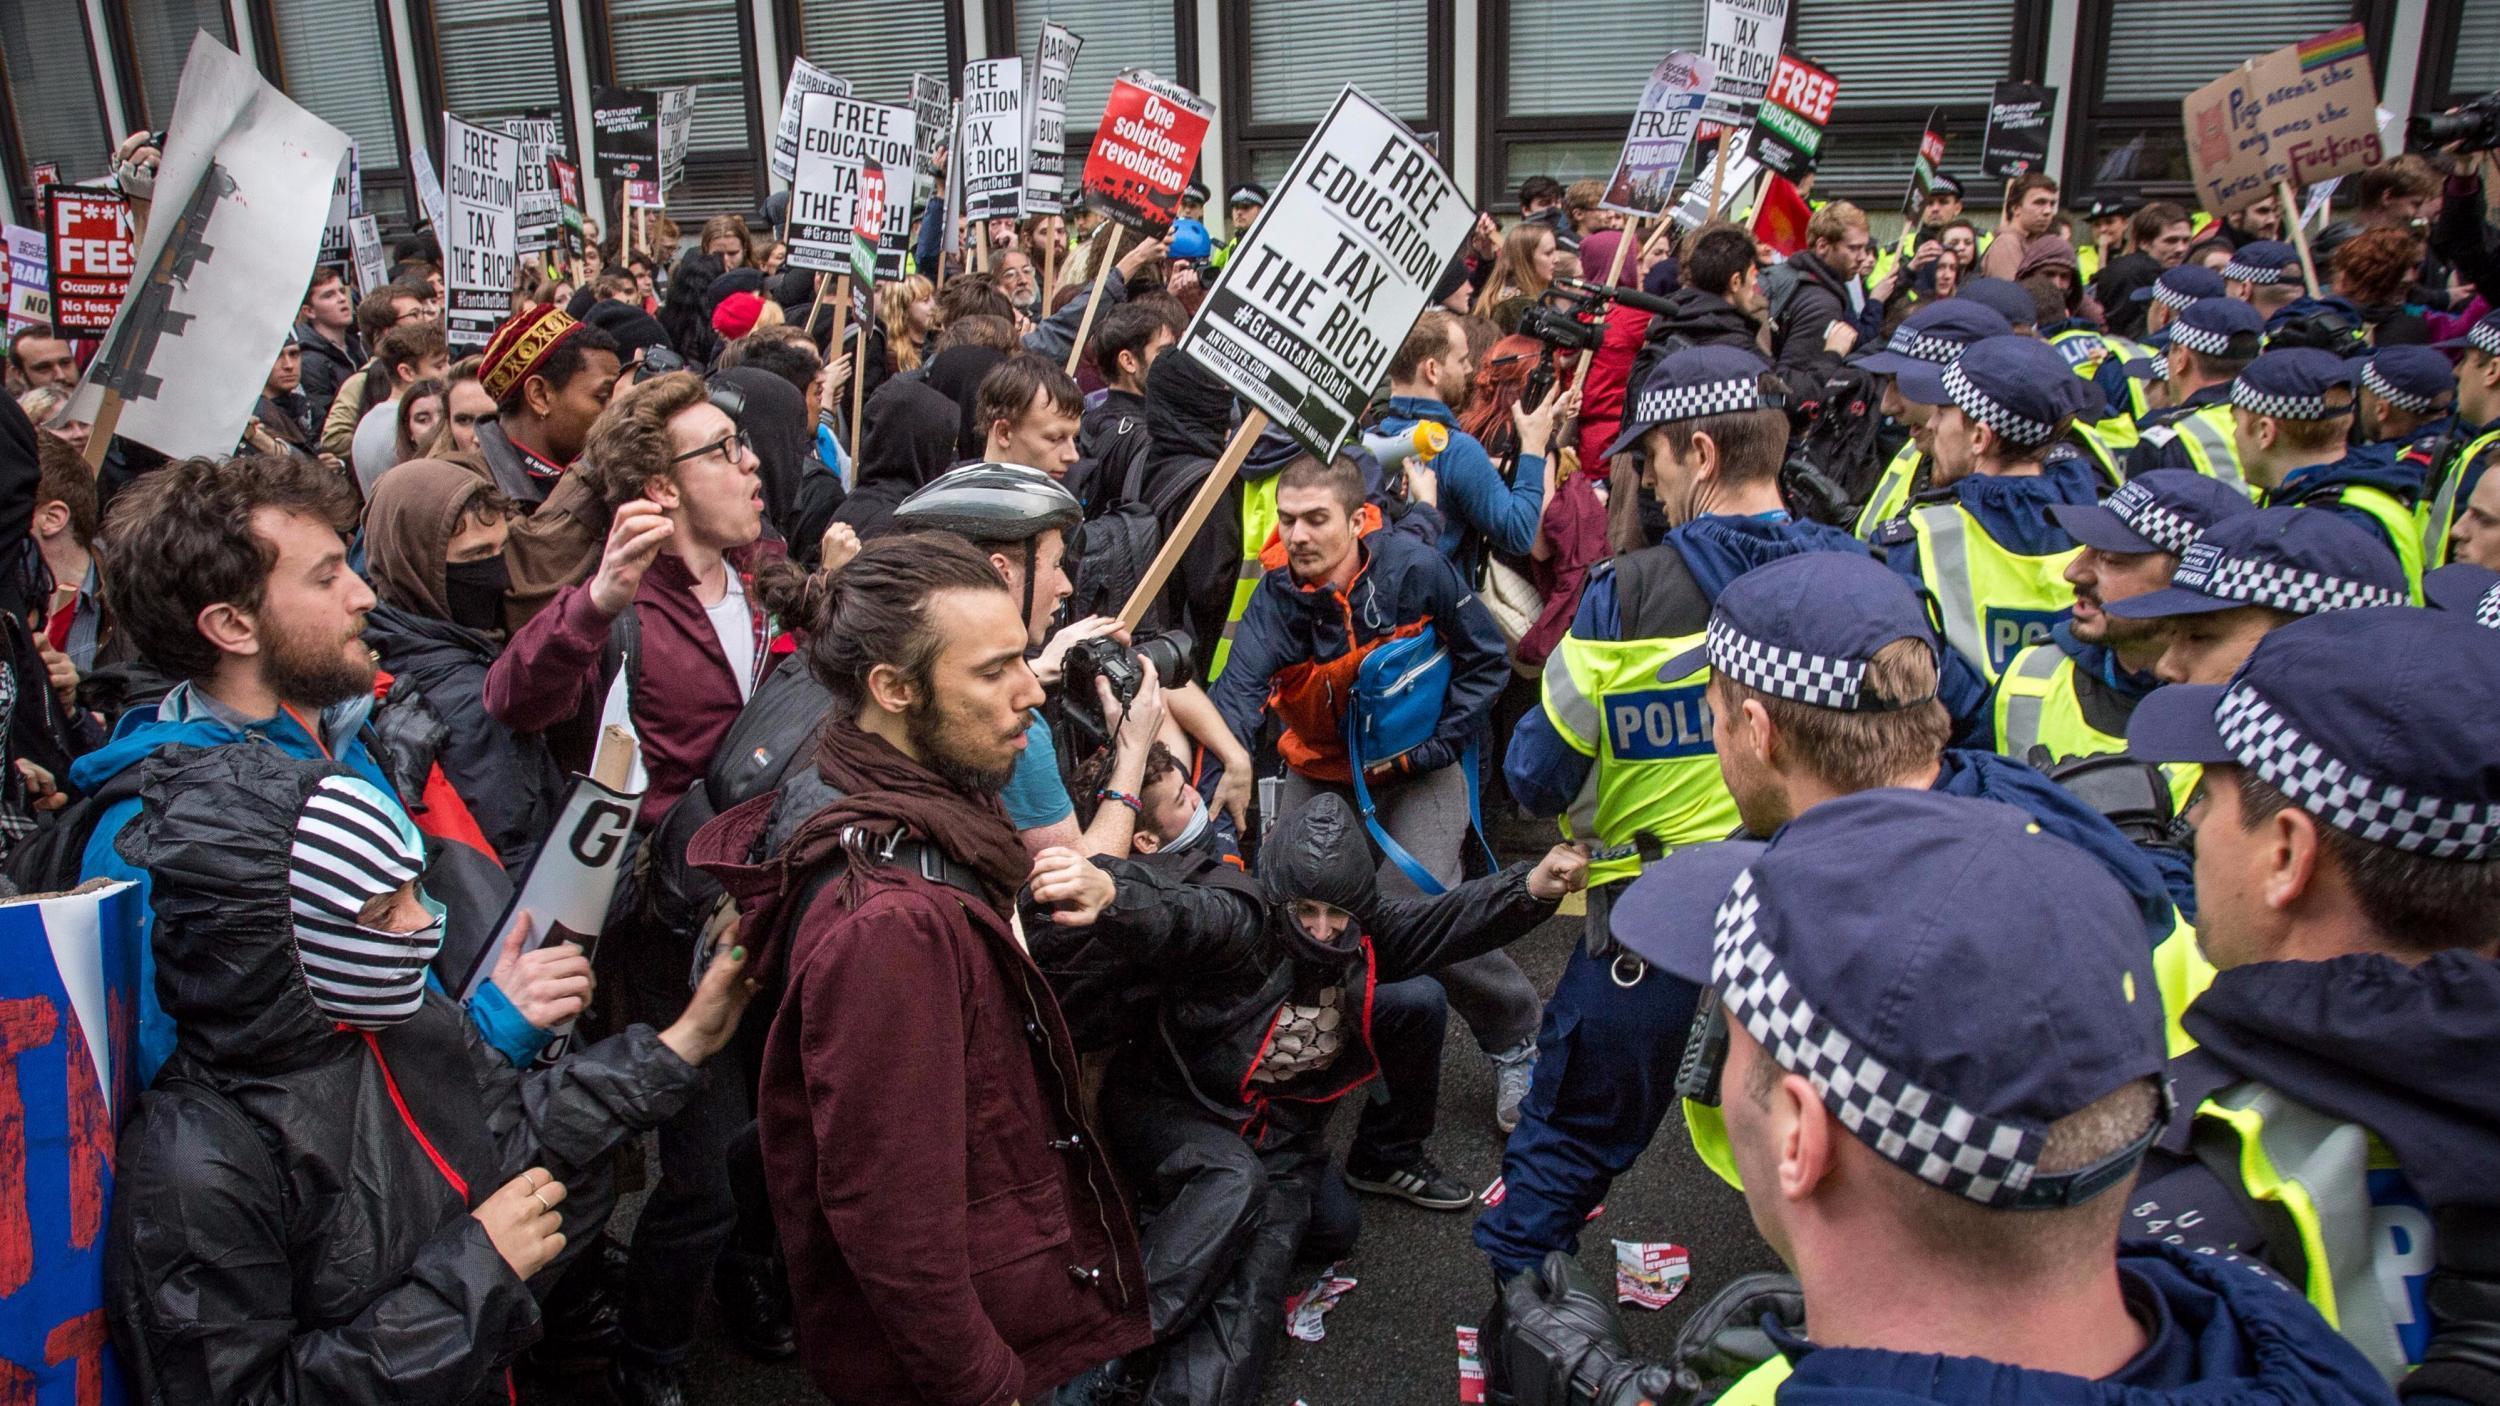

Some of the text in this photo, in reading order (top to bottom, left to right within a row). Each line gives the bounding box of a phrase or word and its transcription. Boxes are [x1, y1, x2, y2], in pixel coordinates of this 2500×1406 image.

[1733, 17, 1760, 49] TAX
[966, 63, 999, 93] FREE
[1711, 43, 1773, 83] THE RICH
[795, 70, 845, 97] BARRIERS
[1771, 61, 1837, 120] FREE
[2229, 85, 2263, 131] Pigs
[2319, 63, 2354, 88] the
[595, 115, 636, 128] ASSEMBLY
[606, 106, 642, 119] STUDENT
[606, 121, 649, 135] AUSTERITY
[832, 101, 891, 137] FREE
[1143, 94, 1176, 130] One
[1634, 111, 1691, 138] FREE
[1761, 101, 1820, 151] EDUCATION
[2317, 101, 2350, 125] the
[463, 128, 499, 172] FREE
[805, 127, 913, 168] EDUCATION
[968, 121, 993, 147] TAX
[1113, 116, 1187, 164] solution:
[522, 145, 541, 163] NOT
[977, 147, 1018, 175] RICH
[1098, 138, 1183, 191] revolution
[1627, 143, 1682, 166] EDUCATION
[2288, 131, 2385, 188] Fucking
[452, 164, 512, 210] EDUCATION
[832, 164, 859, 195] TA
[1369, 133, 1450, 229] FREE
[799, 190, 843, 224] THE
[1306, 152, 1442, 292] EDUCATION
[467, 210, 496, 249] TAX
[453, 246, 513, 290] THE RICH
[1322, 232, 1388, 314] TAX
[61, 280, 106, 295] Occupy
[108, 281, 117, 293] &
[457, 290, 510, 309] #GrantsNotDebt
[62, 301, 81, 312] No
[84, 300, 114, 314] fees,
[62, 314, 110, 326] cuts, no
[1245, 243, 1389, 387] THE RICH
[1205, 328, 1272, 383] ANTICUTS.COM
[1233, 303, 1352, 404] #GrantsNotDebt
[1198, 344, 1232, 375] NATIONAL
[1232, 368, 1270, 402] CAMPAIGN
